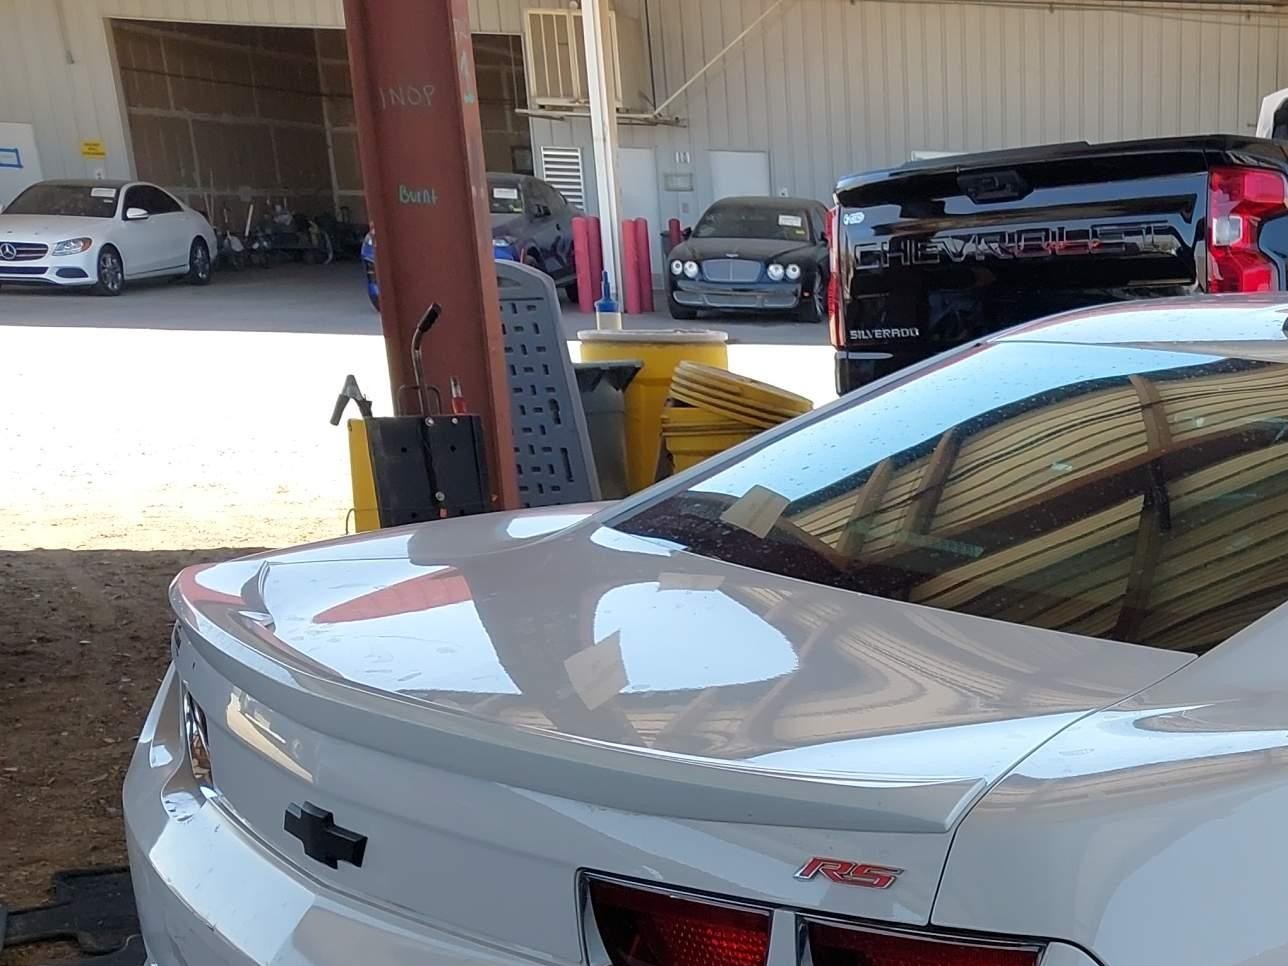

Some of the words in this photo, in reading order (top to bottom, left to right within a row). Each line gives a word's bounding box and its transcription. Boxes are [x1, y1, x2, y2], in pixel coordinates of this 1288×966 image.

[379, 84, 434, 109] INOP
[855, 221, 1177, 270] CHEVROLET
[849, 327, 920, 341] SILVERADO
[793, 857, 904, 889] RS
